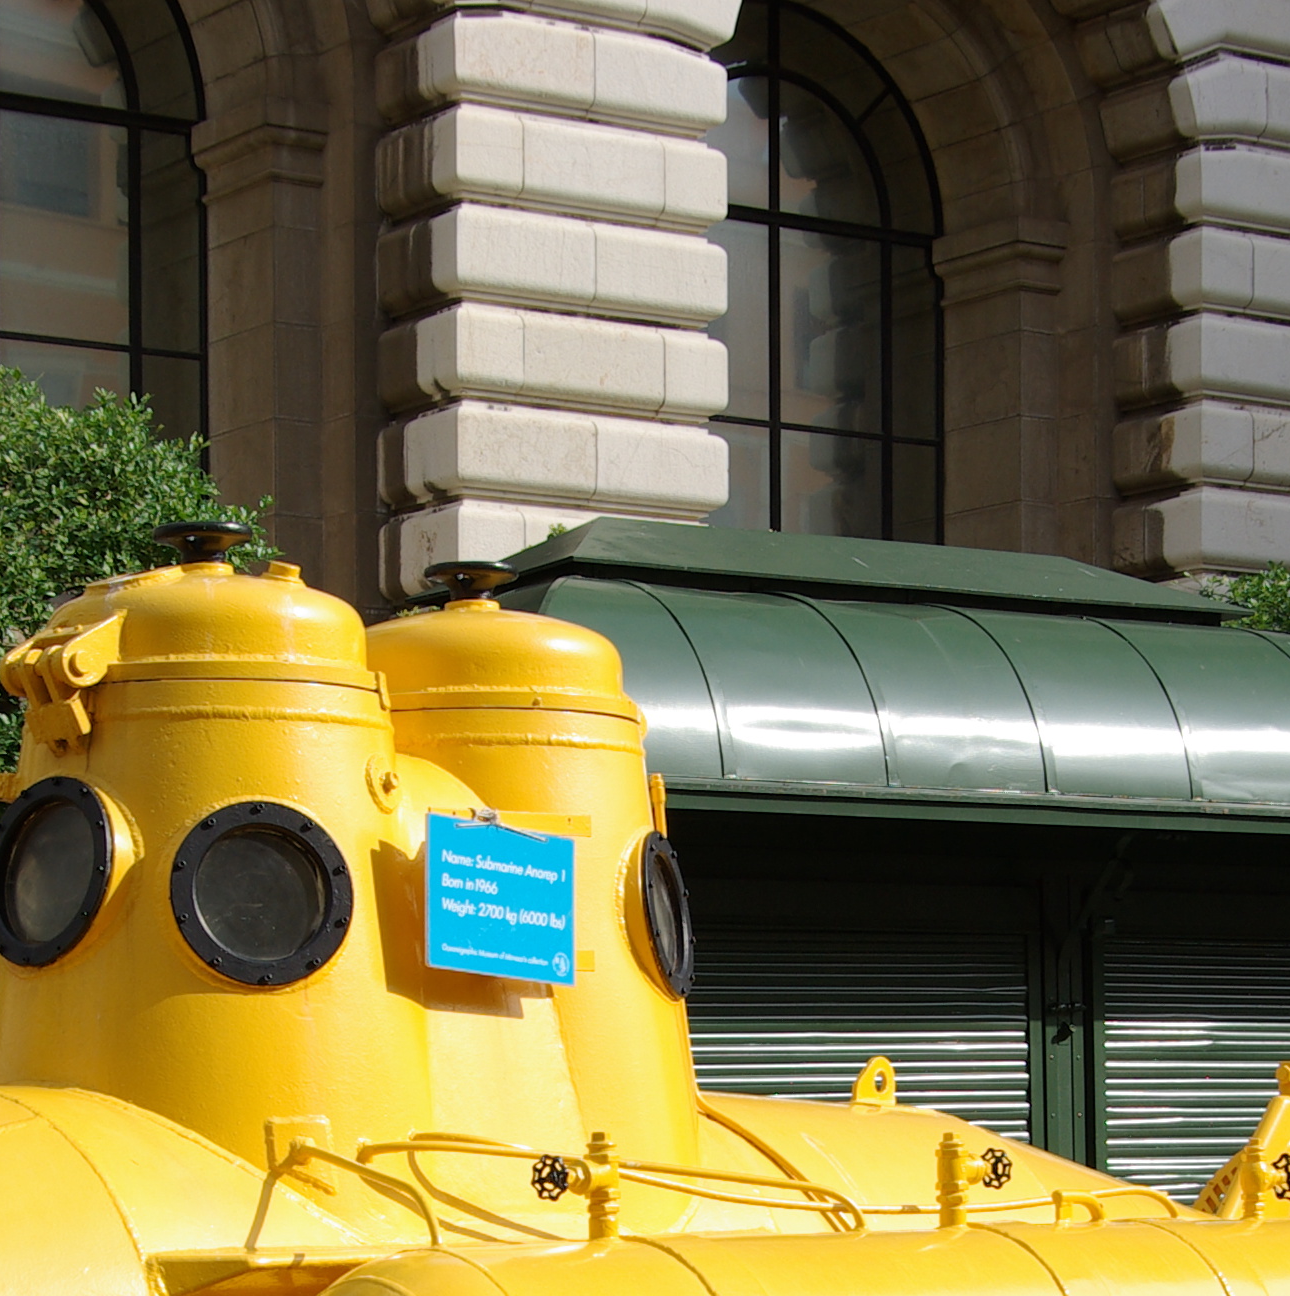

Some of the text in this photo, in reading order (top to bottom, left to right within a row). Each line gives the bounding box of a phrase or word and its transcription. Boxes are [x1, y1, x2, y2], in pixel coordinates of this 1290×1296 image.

[441, 849, 475, 867] Name:
[475, 854, 524, 876] Submarine
[441, 872, 499, 895] Born in 1966
[441, 897, 566, 930] Weight: 2700 kg (6000 lbs)
